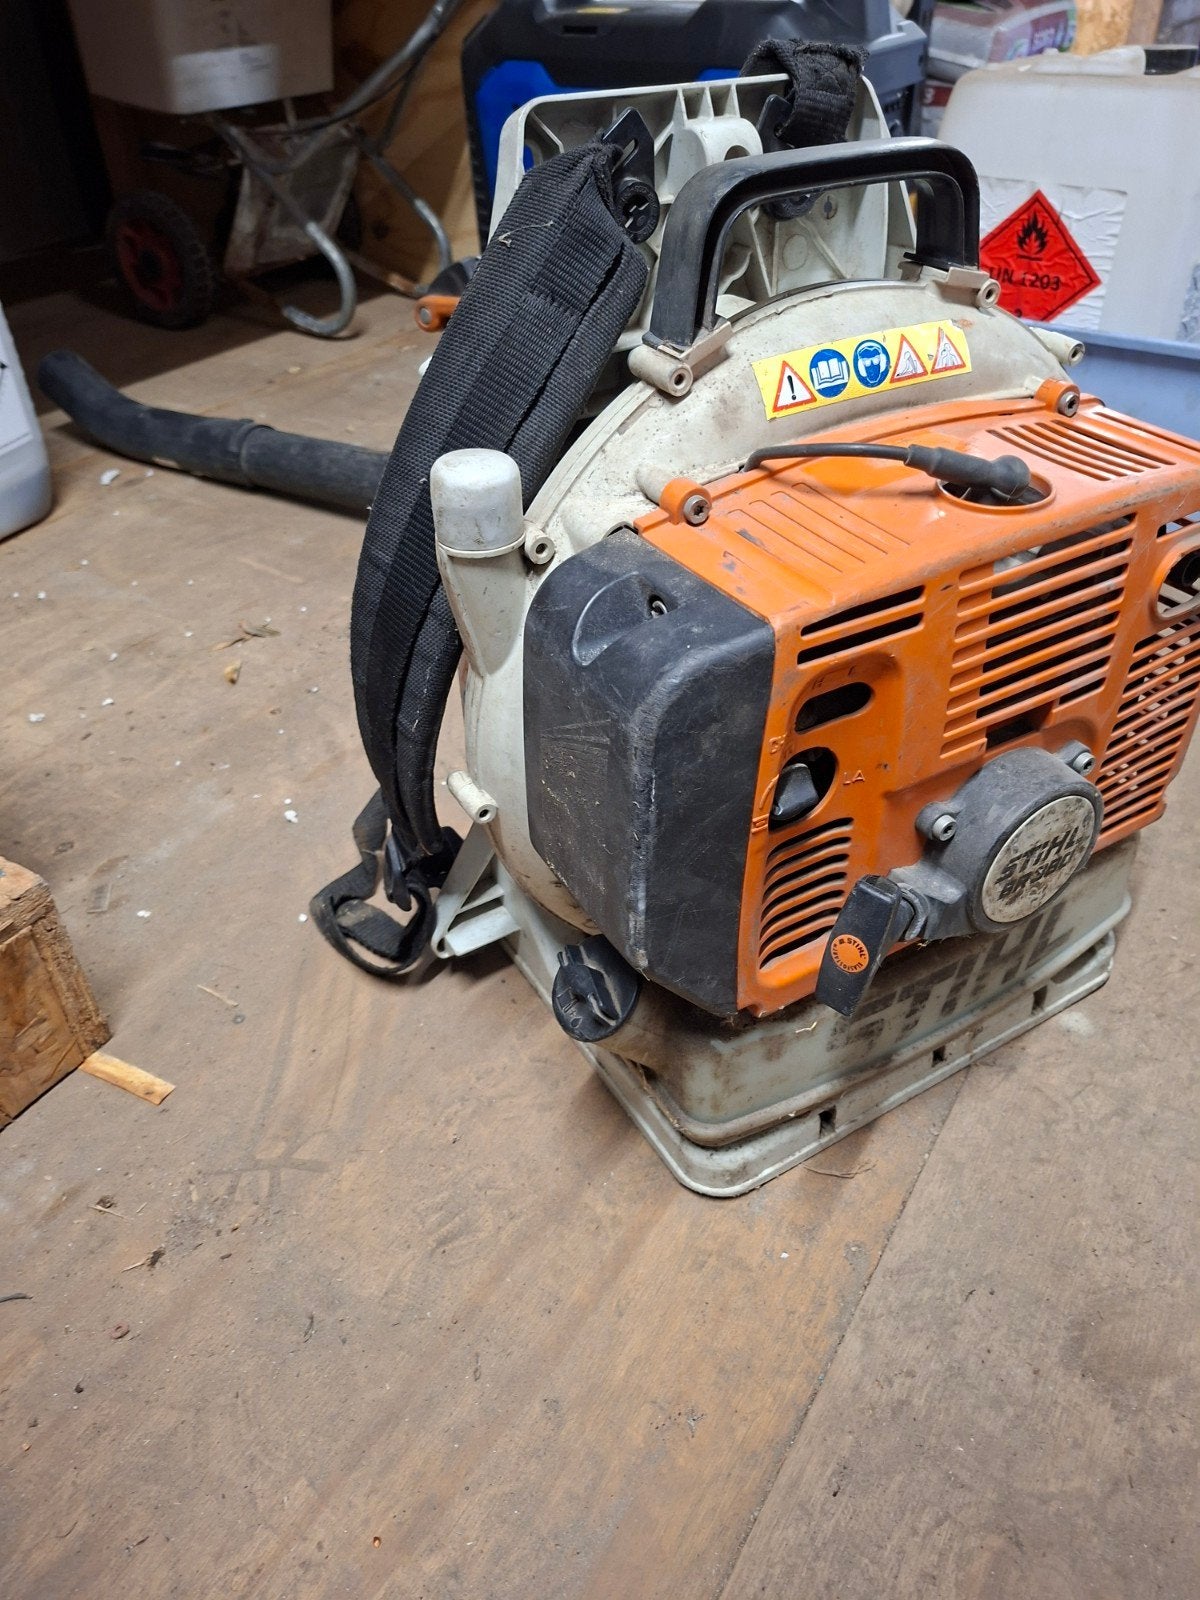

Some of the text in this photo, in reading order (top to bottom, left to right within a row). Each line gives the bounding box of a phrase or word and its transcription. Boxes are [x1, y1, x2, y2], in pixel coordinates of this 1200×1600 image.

[989, 266, 1061, 291] UN 1203
[843, 769, 866, 786] LA
[993, 826, 1082, 886] STIHL
[846, 937, 865, 959] STIHL
[827, 902, 1074, 1053] STIHL
